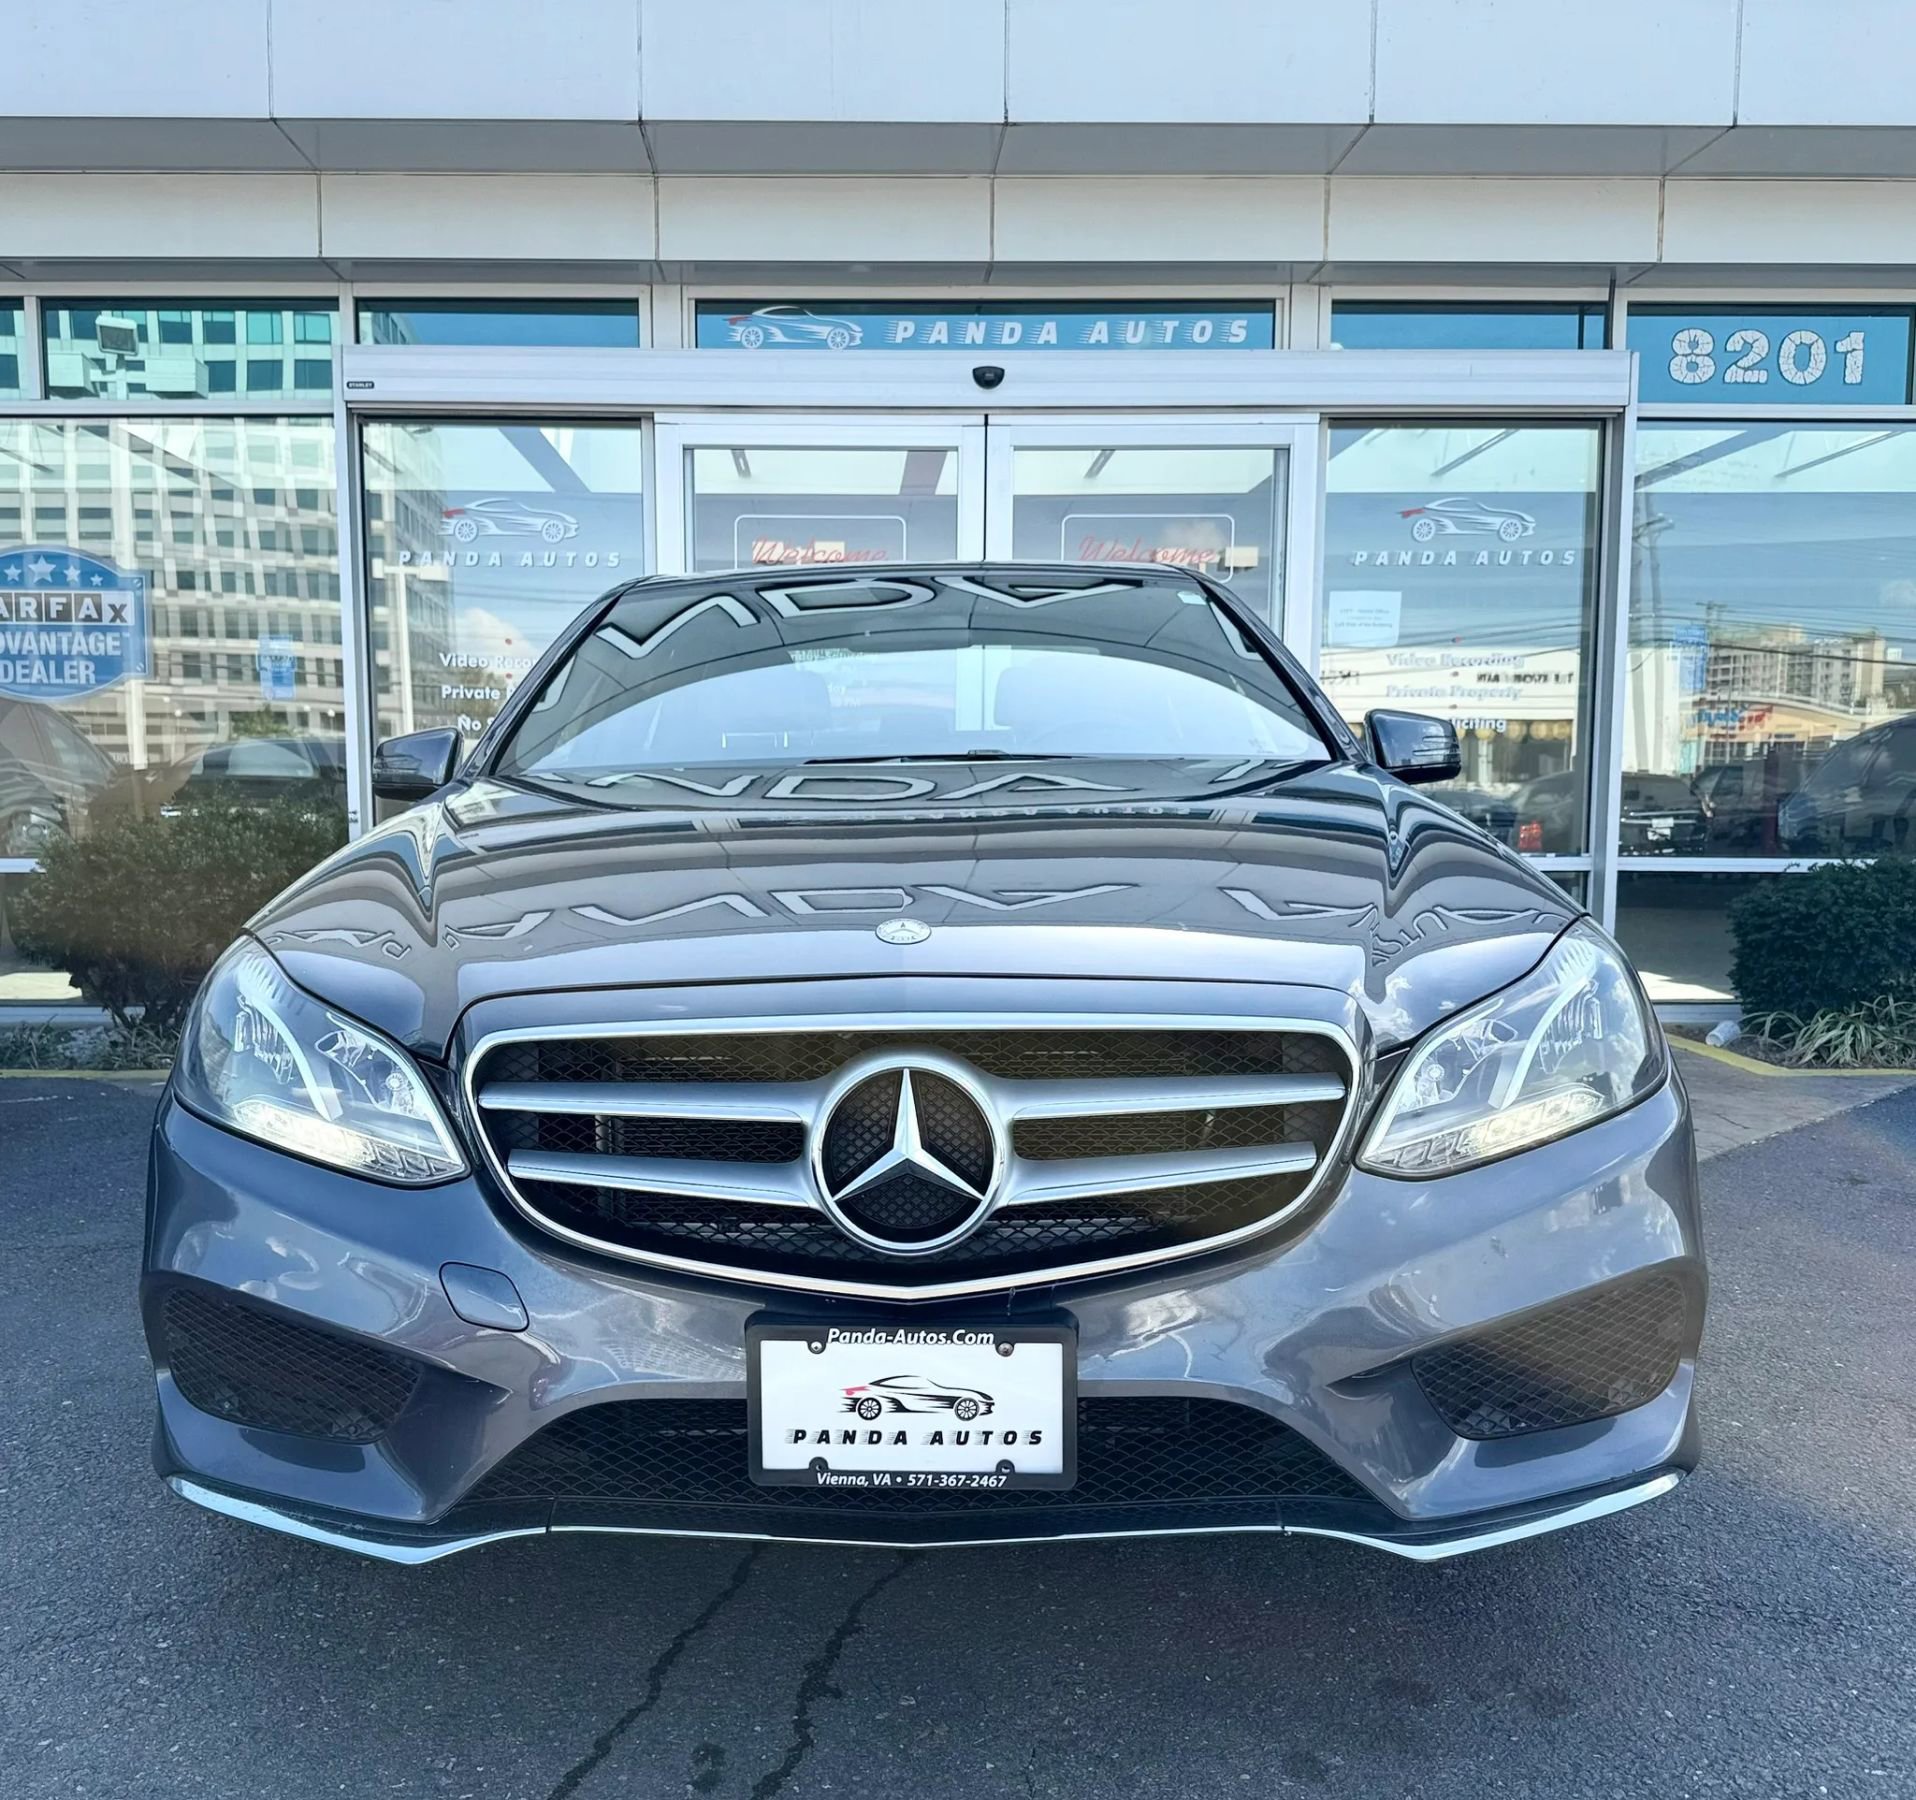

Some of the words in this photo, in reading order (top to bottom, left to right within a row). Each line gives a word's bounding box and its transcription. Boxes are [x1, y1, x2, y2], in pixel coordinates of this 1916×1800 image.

[891, 319, 1058, 345] PANDA
[1087, 319, 1248, 344] AUTOS
[1668, 328, 1865, 386] 8201
[751, 534, 889, 564] Welcome
[1078, 532, 1218, 563] Welcome
[400, 551, 502, 568] PANDA
[521, 551, 621, 568] AUTOS
[1353, 550, 1457, 566] PANDA
[1476, 550, 1576, 566] AUTOS
[439, 652, 489, 669] Video
[495, 654, 537, 669] Recor
[1385, 652, 1437, 668] Video
[1440, 652, 1525, 669] Recording
[0, 660, 96, 684] DEALER
[441, 685, 501, 700] Private
[1385, 685, 1445, 699] Private
[1449, 685, 1524, 701] Property
[457, 714, 482, 731] No
[1451, 718, 1507, 733] liciting
[827, 1327, 995, 1346] Panda-Autos.Com
[790, 1428, 908, 1446] PANDA
[927, 1428, 1043, 1446] AUTOS
[816, 1472, 871, 1488] Vienna,
[873, 1473, 892, 1486] VA
[906, 1473, 1007, 1488] 571-367-2467
